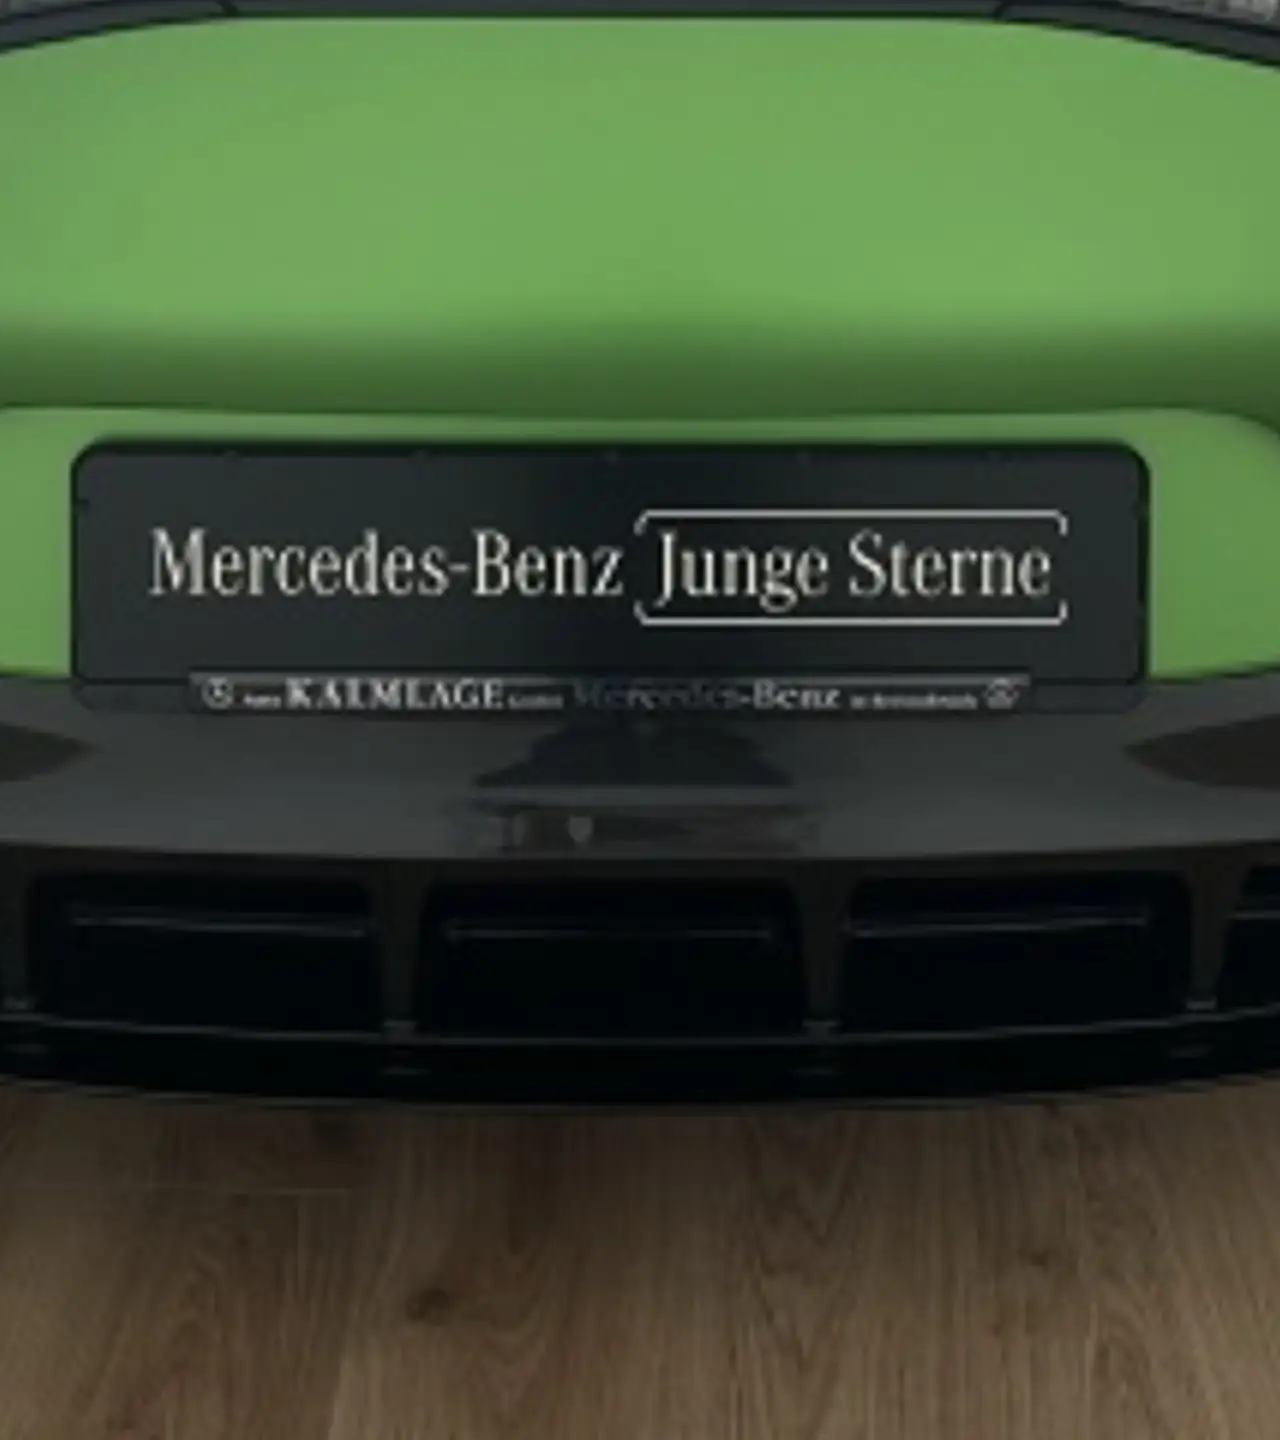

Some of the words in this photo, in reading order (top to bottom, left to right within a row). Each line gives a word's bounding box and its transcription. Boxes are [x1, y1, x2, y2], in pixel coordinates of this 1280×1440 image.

[148, 526, 625, 597] Mercedes-Benz
[658, 528, 829, 614] Junge
[848, 528, 1053, 598] Sterne
[286, 676, 503, 710] KALMLAGE
